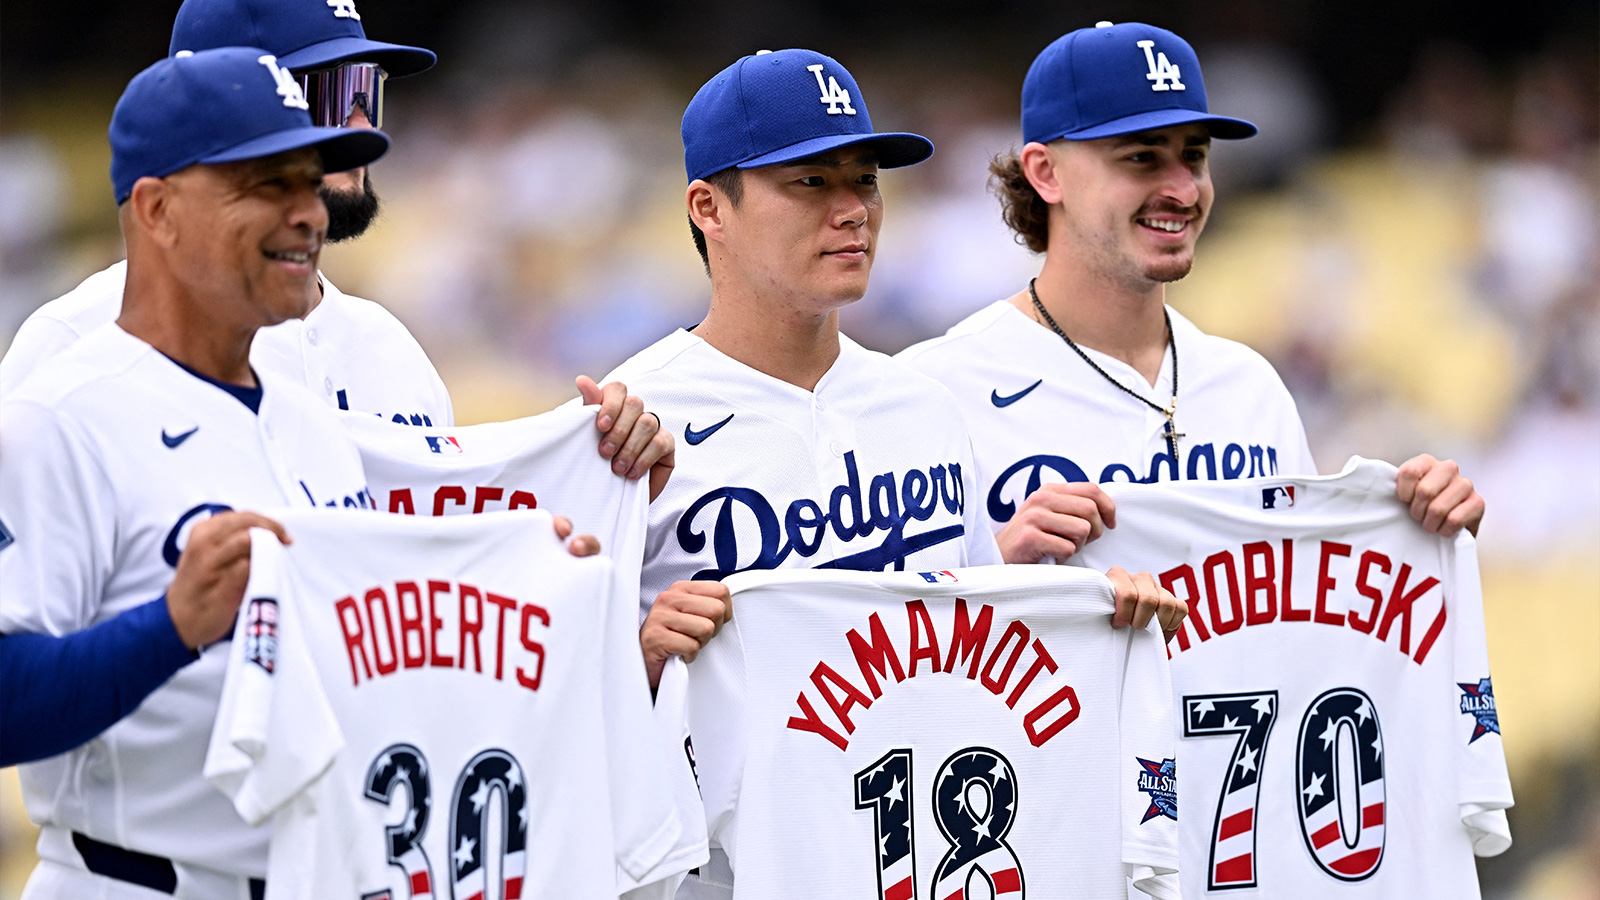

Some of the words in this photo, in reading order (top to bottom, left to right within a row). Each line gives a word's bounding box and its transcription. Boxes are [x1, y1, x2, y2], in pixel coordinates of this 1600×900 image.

[807, 64, 857, 115] LA
[1137, 40, 1186, 91] LA
[335, 579, 551, 691] ROBERTS
[1158, 538, 1447, 666] ROBLESKI
[787, 597, 1081, 752] YAMAMOTO
[361, 742, 528, 900] 30
[854, 746, 1026, 900] 18
[1139, 773, 1160, 789] ALL
[1182, 687, 1386, 891] 70
